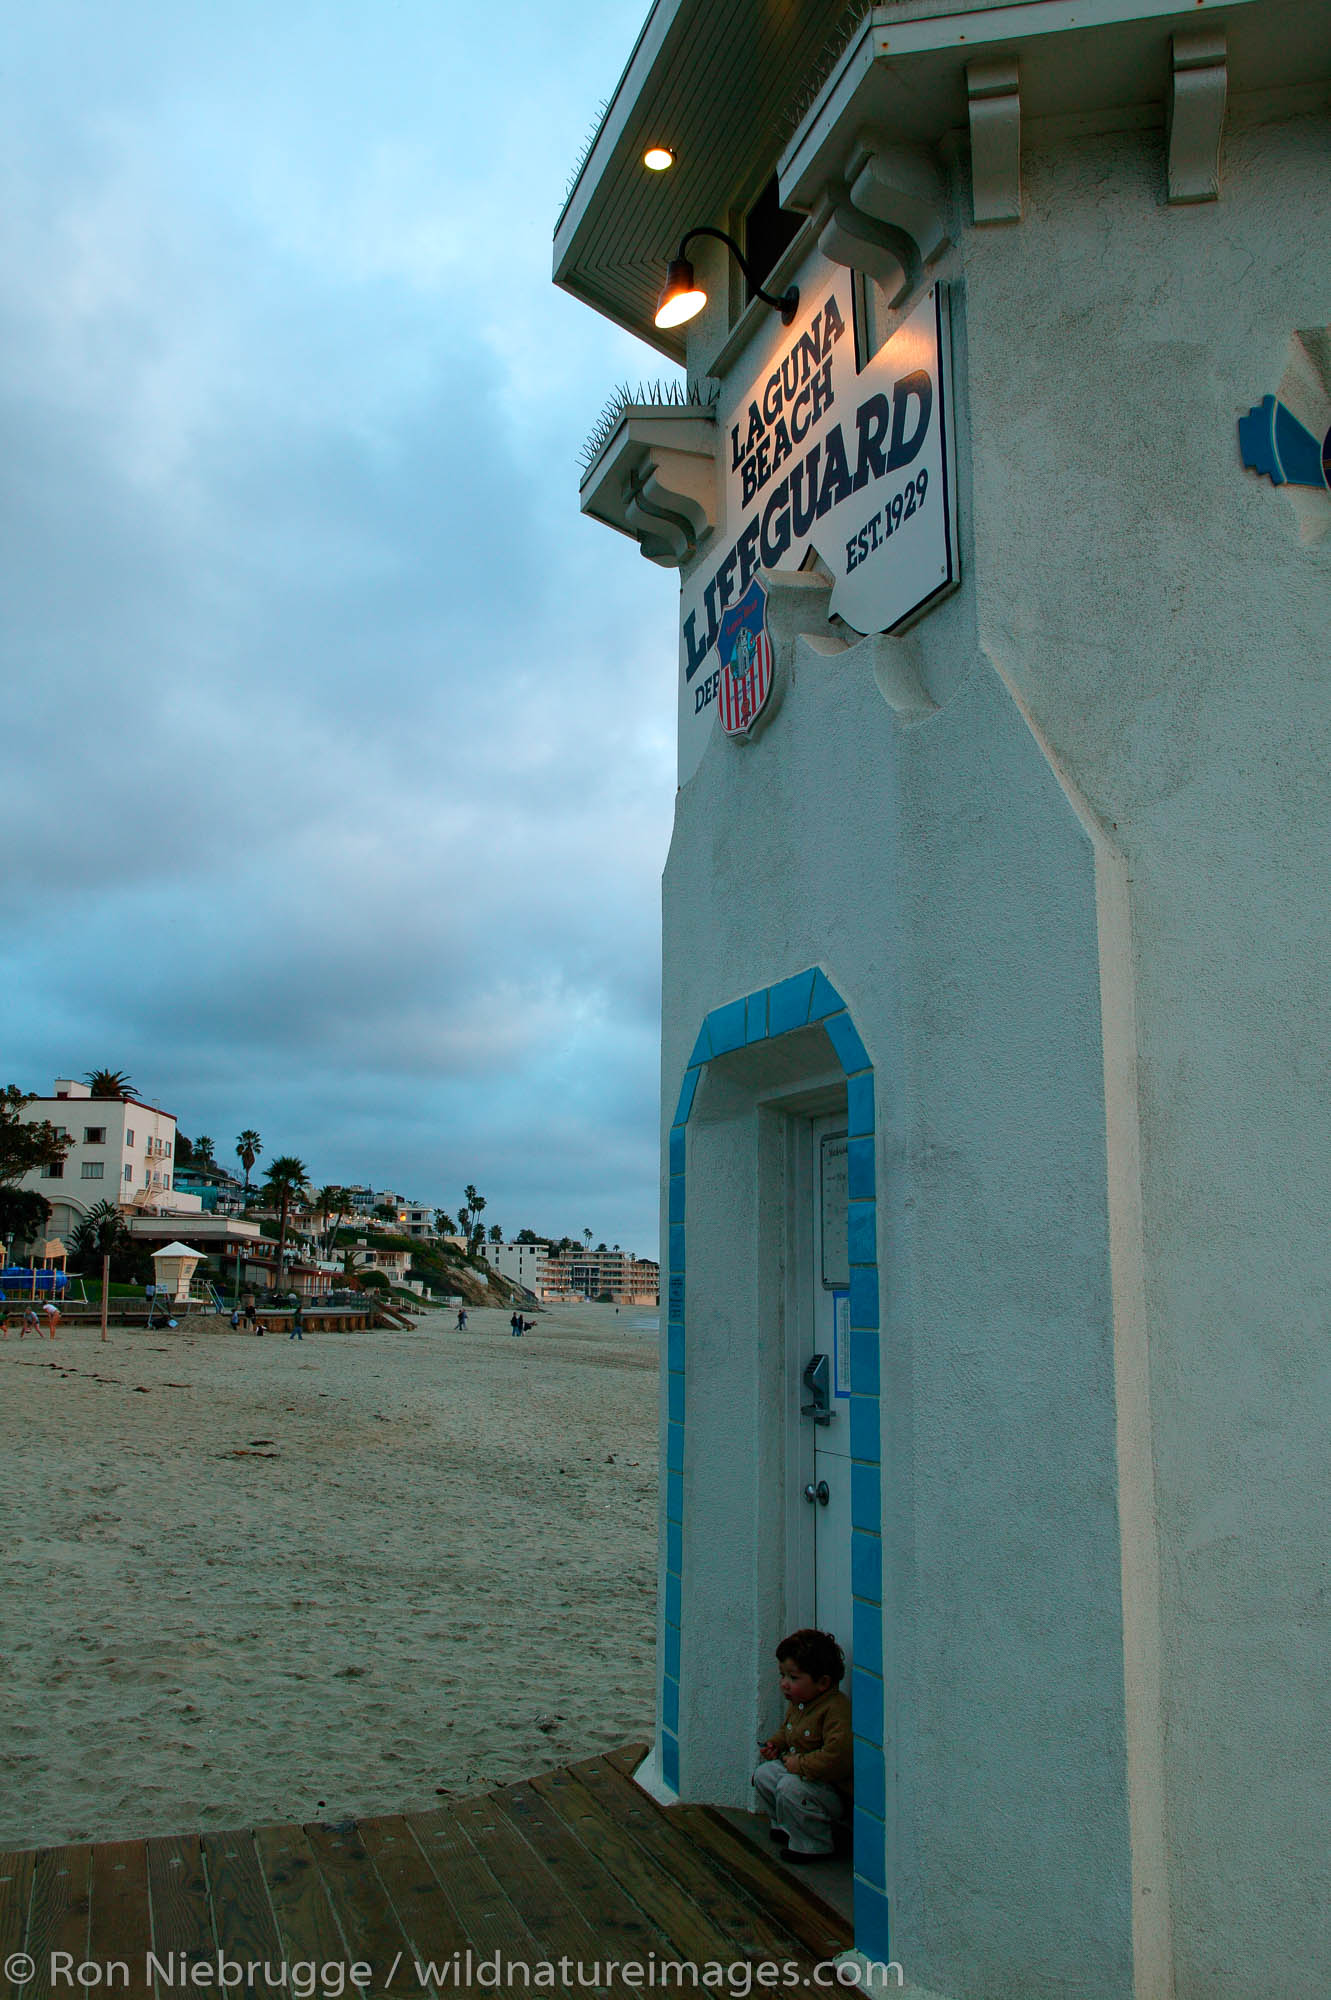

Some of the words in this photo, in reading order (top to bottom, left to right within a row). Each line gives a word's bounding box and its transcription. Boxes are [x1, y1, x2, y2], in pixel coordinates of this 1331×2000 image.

[731, 294, 845, 473] LAGUNA
[741, 354, 835, 511] BEACH
[683, 369, 933, 684] LIFEGUARD
